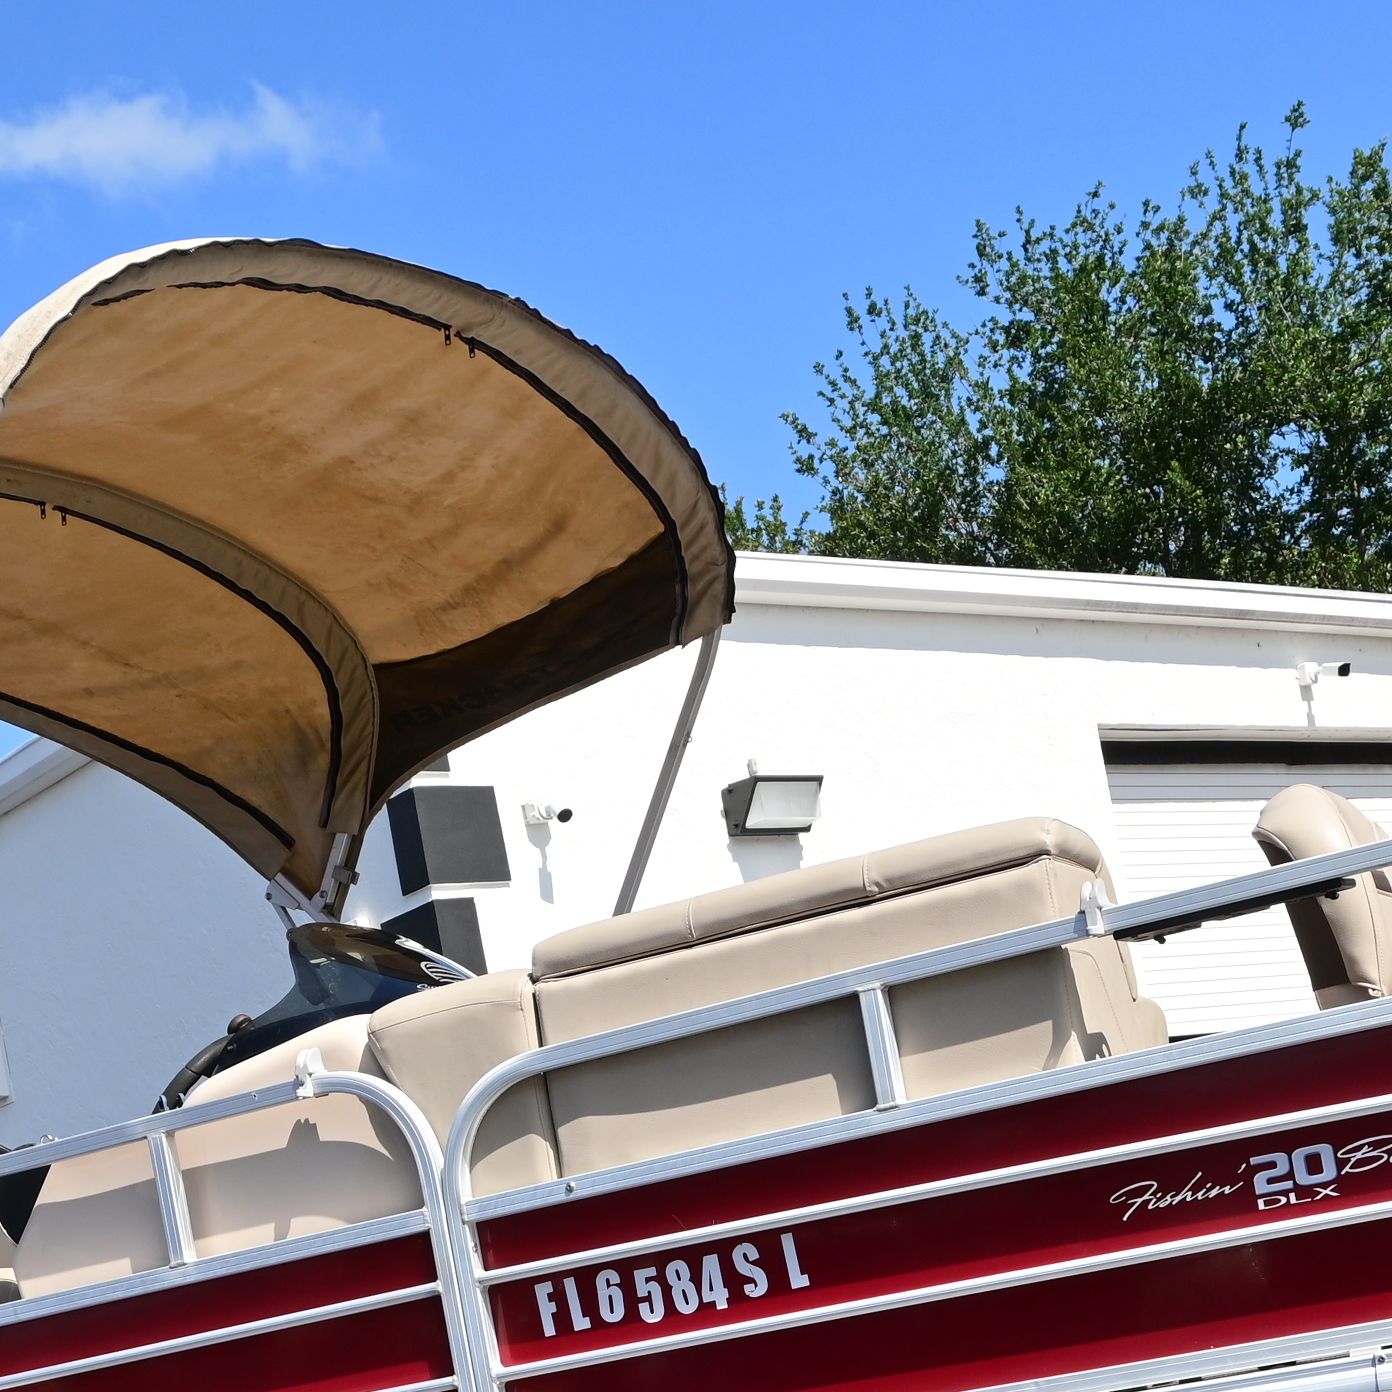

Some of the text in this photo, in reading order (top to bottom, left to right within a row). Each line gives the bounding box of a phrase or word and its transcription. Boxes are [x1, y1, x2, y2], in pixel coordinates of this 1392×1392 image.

[1109, 1162, 1247, 1222] Fishin'
[1249, 1142, 1339, 1197] 20
[1257, 1183, 1341, 1211] DLX
